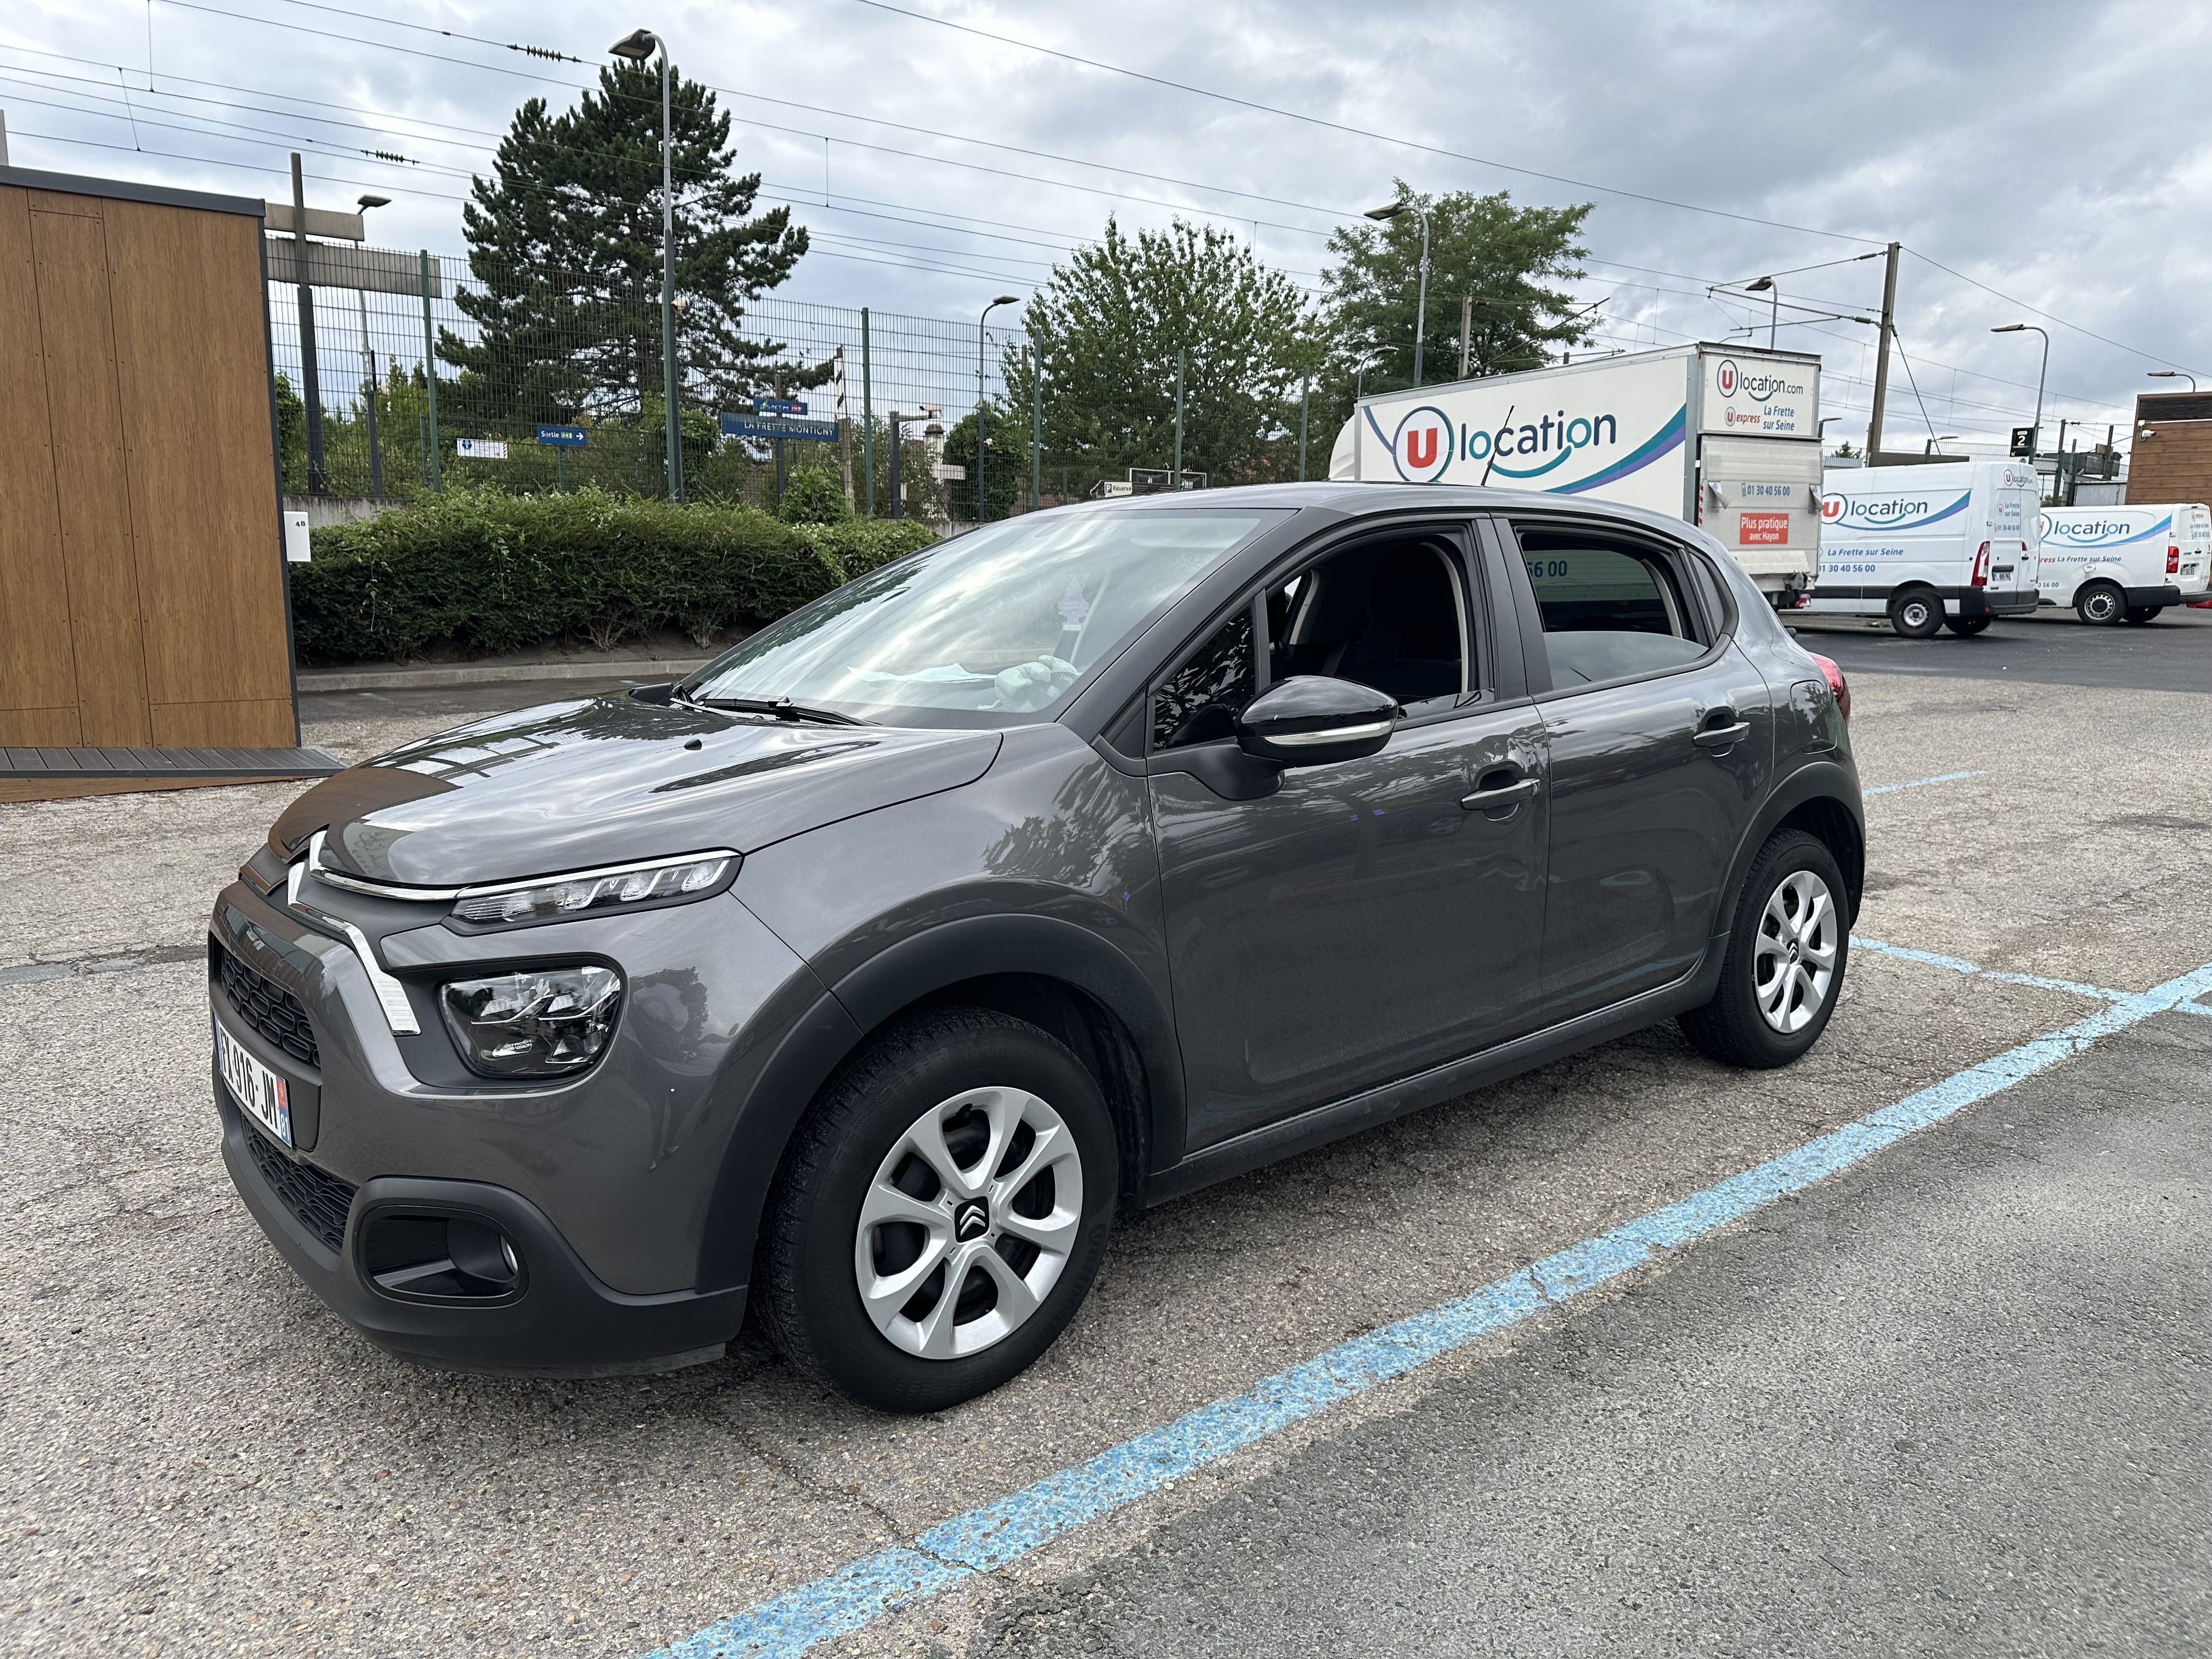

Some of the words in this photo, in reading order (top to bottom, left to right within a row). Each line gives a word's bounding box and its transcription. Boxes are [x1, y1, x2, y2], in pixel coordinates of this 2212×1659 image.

[1722, 370, 1733, 389] U
[1740, 371, 1803, 394] location.com
[1764, 405, 1771, 415] La
[1773, 406, 1795, 417] Frette
[1727, 412, 1733, 422] U
[1736, 414, 1760, 425] express
[1763, 421, 1774, 429] sur
[1776, 420, 1795, 431] Seine
[789, 425, 833, 436] MONTIGNY
[1408, 427, 1437, 469] U
[1461, 410, 1616, 461] location
[2017, 435, 2025, 446] 2
[1747, 485, 1754, 495] 01
[1756, 485, 1764, 495] 30
[1765, 486, 1773, 496] 40
[1774, 486, 1782, 495] 56
[1782, 486, 1790, 496] 00
[1822, 501, 1840, 517] U
[1851, 499, 1928, 516] location
[1741, 516, 1757, 529] Plus
[1758, 517, 1788, 531] pratique
[2054, 520, 2130, 535] location
[1762, 532, 1779, 542] Hayon
[1548, 560, 1568, 577] 00
[280, 1113, 290, 1141] 81
